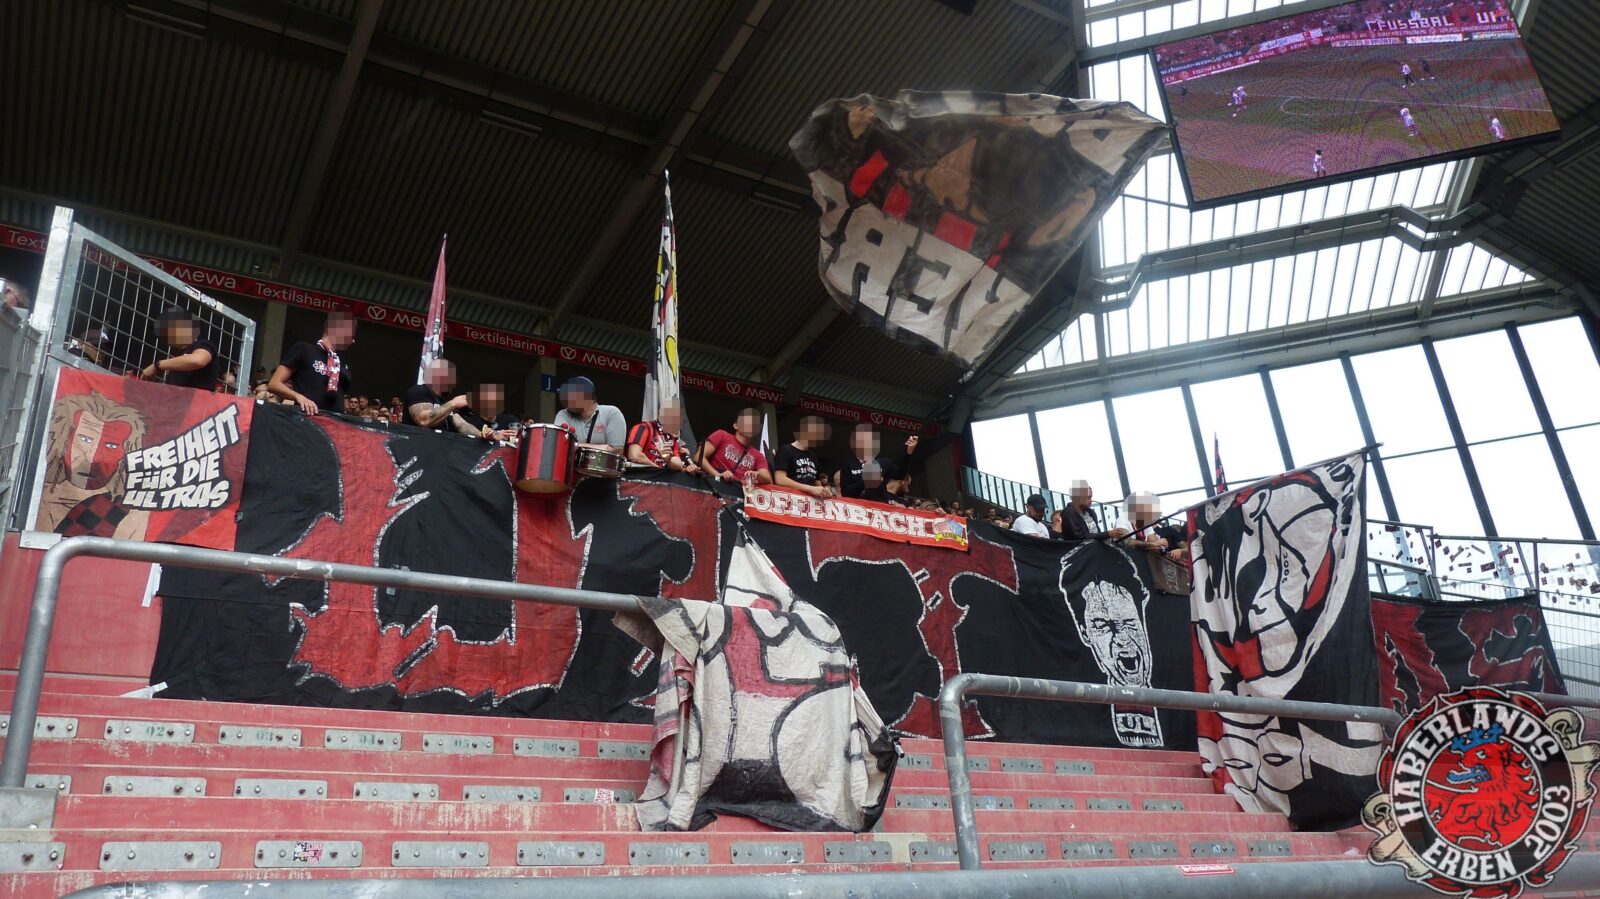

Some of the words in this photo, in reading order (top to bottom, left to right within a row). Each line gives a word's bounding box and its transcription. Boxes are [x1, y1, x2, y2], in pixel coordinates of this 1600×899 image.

[463, 326, 546, 356] Textilsharing
[799, 397, 861, 421] Textilsharing
[126, 404, 239, 472] FREIHEIT
[126, 466, 177, 490] FÜR
[182, 451, 221, 485] DIE
[122, 480, 230, 509] ULTRAS
[752, 487, 926, 537] OFFENBACH
[1121, 715, 1152, 732] UL
